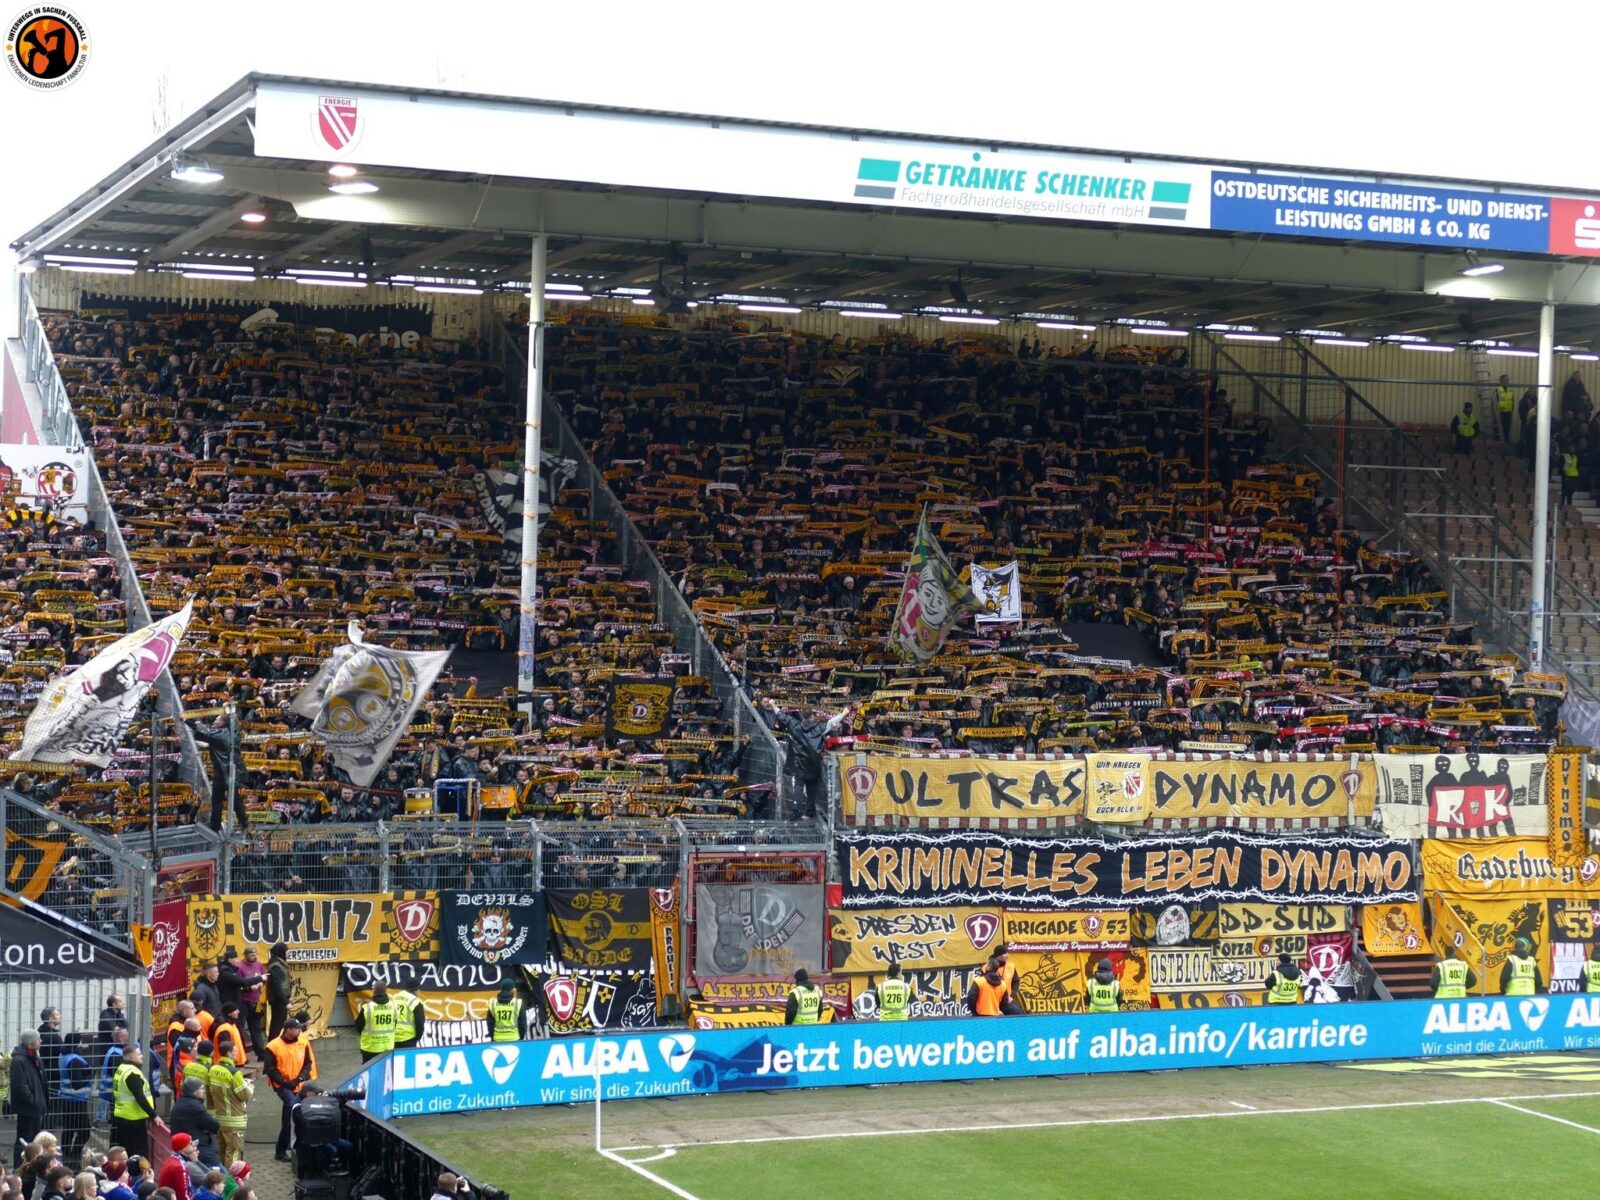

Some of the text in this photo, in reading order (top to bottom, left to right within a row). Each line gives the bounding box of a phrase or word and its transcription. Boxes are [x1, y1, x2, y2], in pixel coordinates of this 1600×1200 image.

[325, 98, 351, 106] ENERGIE
[1034, 171, 1146, 200] SCHENKER
[900, 188, 1144, 218] Fachgroßhandelsgesellschaft mbH
[1214, 179, 1548, 221] OSTDEUTSCHE SICHERHEITS- UND DIENST-
[1275, 208, 1490, 240] LEISTUNGS GMBH & CO. KG
[1096, 761, 1110, 769] WIR
[885, 768, 1084, 810] ULTRAS
[1155, 769, 1336, 809] DYNAMO
[1096, 806, 1115, 814] EUCH
[1117, 805, 1134, 813] ALLE
[1436, 789, 1465, 826] R
[1485, 788, 1509, 821] K
[850, 845, 1411, 896] KRIMINELLES LEBEN DYNAMO
[456, 893, 534, 907] DEVILS
[241, 894, 373, 944] GÖRLITZ
[854, 913, 956, 940] DRESDEN
[1007, 920, 1077, 936] BRIGADE
[1107, 919, 1127, 935] 53
[1565, 912, 1593, 938] 53
[390, 928, 434, 952] DRESDEN
[457, 924, 529, 961] Dynamo Dresden
[872, 939, 946, 964] WEST
[1007, 940, 1128, 952] Sportgemeinschaft Dynamo Dresden
[1212, 942, 1253, 956] Forza
[1275, 936, 1306, 953] SGD
[0, 942, 95, 966] on.eu
[287, 949, 337, 960] ERSCHLESIEN
[823, 983, 850, 997] 53
[886, 993, 902, 1004] 276
[1283, 982, 1298, 992] 337
[803, 997, 818, 1008] 339
[1564, 997, 1600, 1028] AL
[375, 1014, 392, 1025] 166
[497, 1009, 512, 1021] 137
[1423, 1001, 1511, 1034] ALBA
[757, 1019, 1368, 1075] Jetzt bewerben auf alba.info/karriere
[1422, 1036, 1549, 1054] Wir sind die Zukunft.
[1564, 1034, 1583, 1048] Wir
[541, 1038, 650, 1080] ALBA
[541, 1079, 696, 1102] Wir sind die Zukunft.
[392, 1091, 520, 1115] sind die Zukunft.
